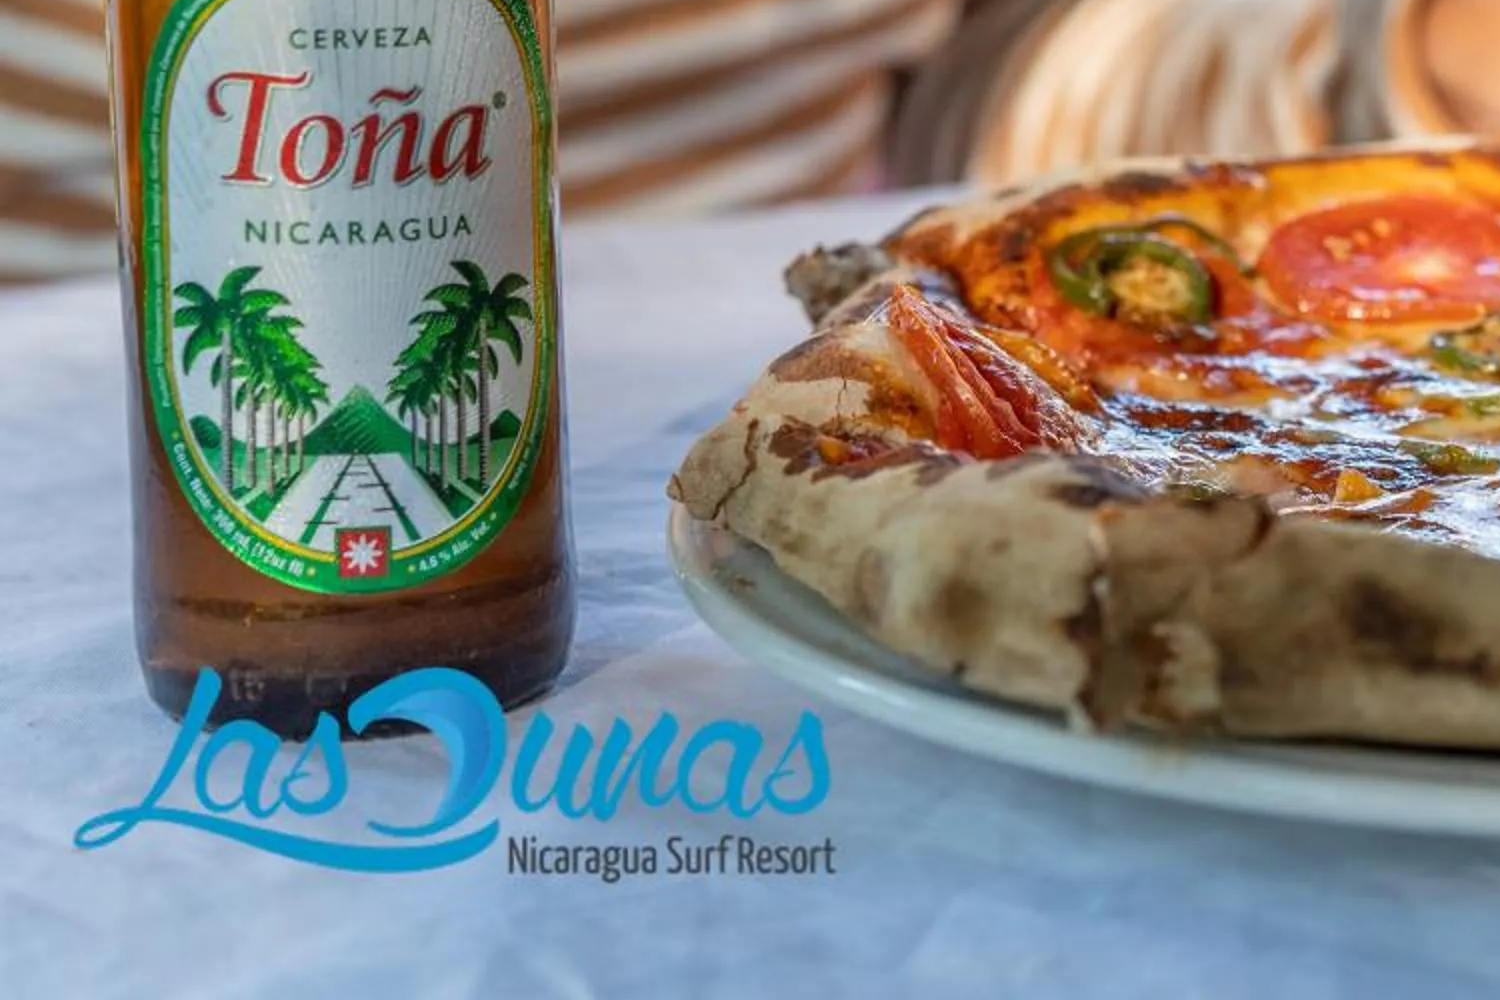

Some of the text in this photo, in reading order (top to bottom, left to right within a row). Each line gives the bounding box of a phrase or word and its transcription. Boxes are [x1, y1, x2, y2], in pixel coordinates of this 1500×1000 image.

[289, 27, 432, 50] CERVEZA
[207, 71, 493, 190] Toña
[244, 215, 473, 246] NICARAGUA
